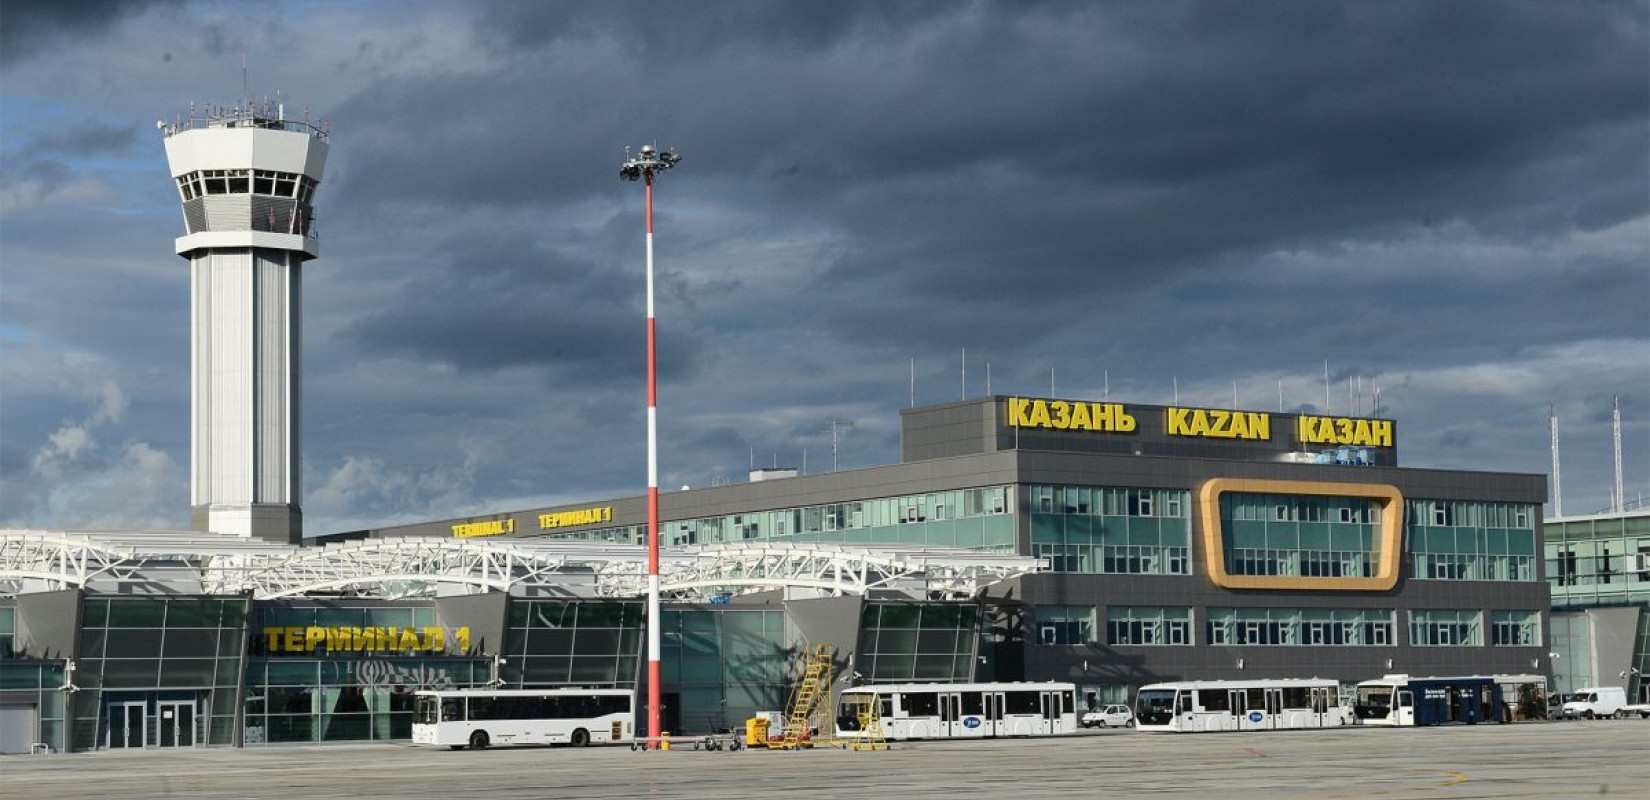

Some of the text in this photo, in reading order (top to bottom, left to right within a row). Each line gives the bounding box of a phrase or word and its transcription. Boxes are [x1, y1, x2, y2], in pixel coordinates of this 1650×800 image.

[1007, 397, 1137, 432] КАЗАНЬ
[1166, 407, 1270, 440] KAZAN
[1298, 415, 1393, 447] КАЗАН
[452, 518, 514, 538] TERMINAL 1
[538, 507, 612, 530] ТЕРМИНАЛ 1
[263, 626, 470, 652] ТЕРМИНАЛ 1
